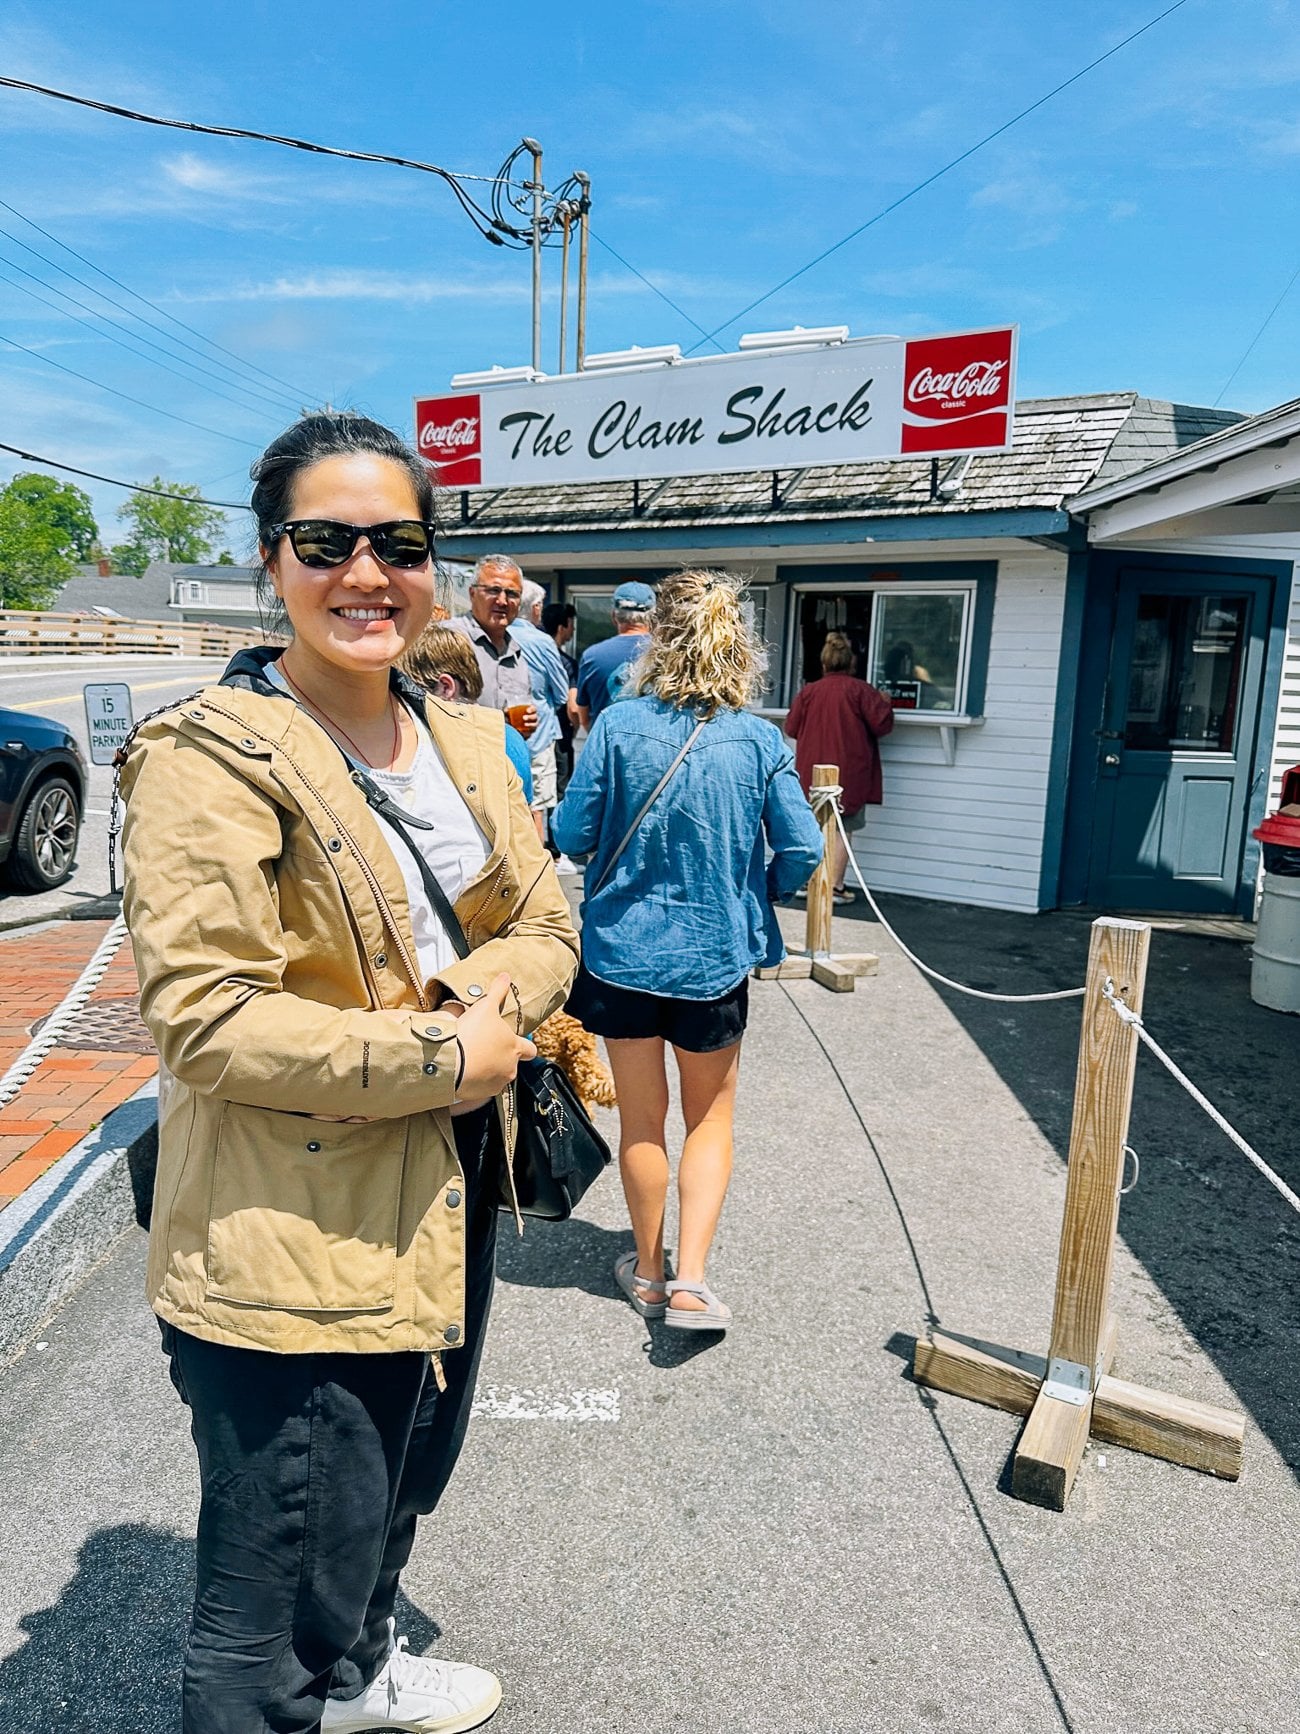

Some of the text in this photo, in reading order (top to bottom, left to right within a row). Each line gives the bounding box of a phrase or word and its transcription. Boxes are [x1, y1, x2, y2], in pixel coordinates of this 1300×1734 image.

[906, 359, 1007, 402] Coca-Cola
[941, 400, 966, 409] classic
[499, 378, 873, 460] The Clam Shack
[420, 417, 479, 448] Coca-Cola
[101, 698, 115, 713] 15
[92, 718, 128, 731] MINUTE
[92, 735, 126, 748] PARKIN
